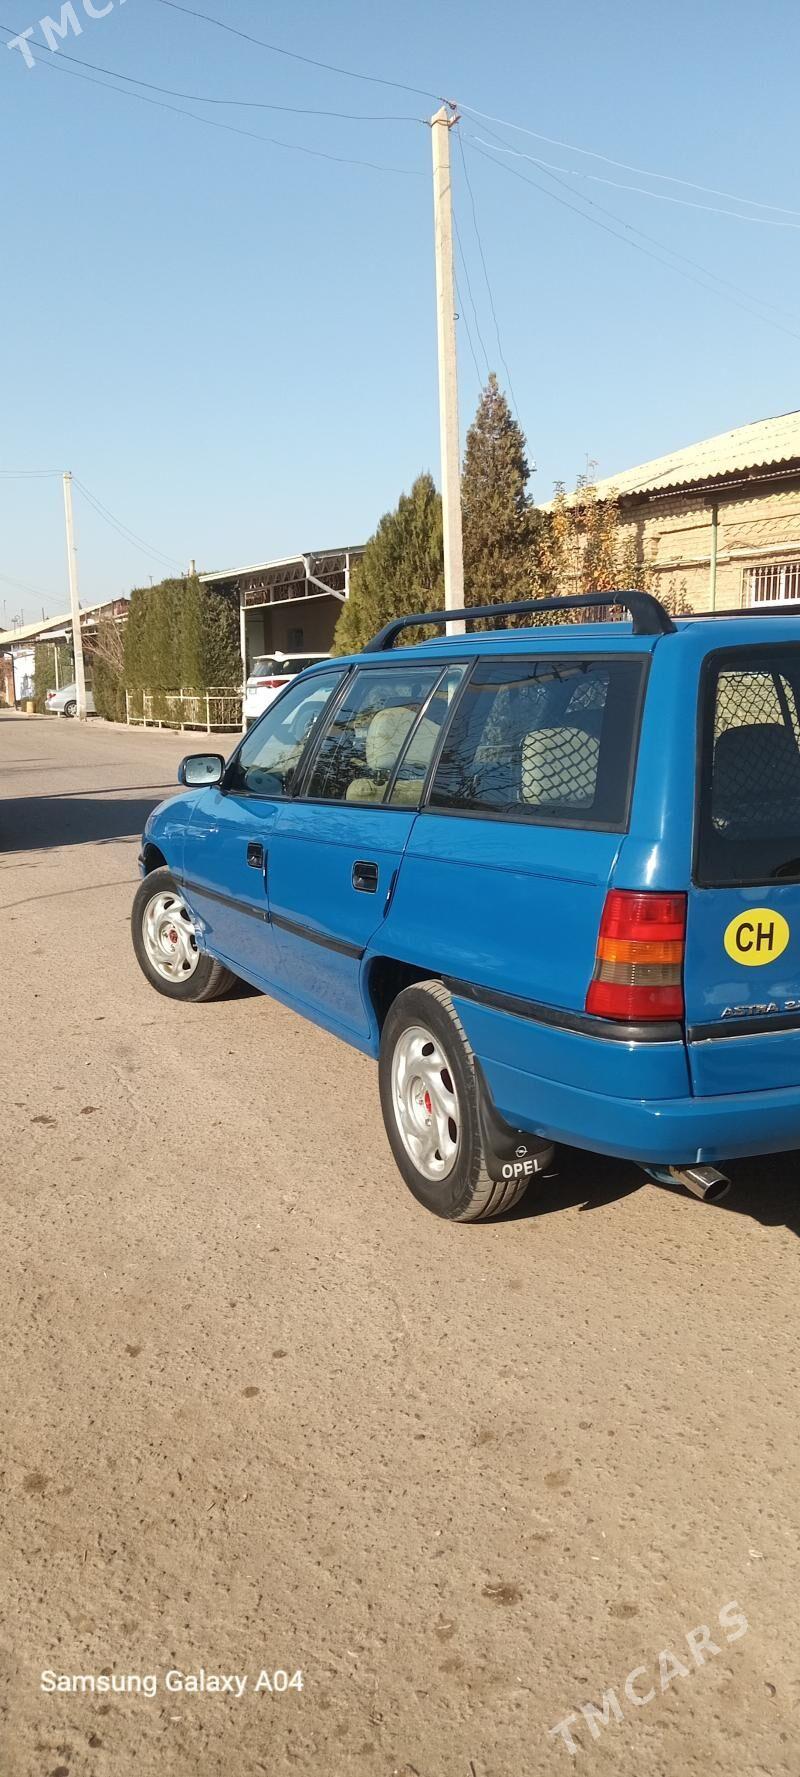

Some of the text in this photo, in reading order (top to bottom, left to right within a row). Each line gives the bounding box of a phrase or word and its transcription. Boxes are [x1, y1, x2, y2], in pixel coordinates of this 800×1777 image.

[735, 922, 774, 952] CH
[720, 1002, 778, 1018] ASTRA
[502, 1159, 542, 1179] OPEL
